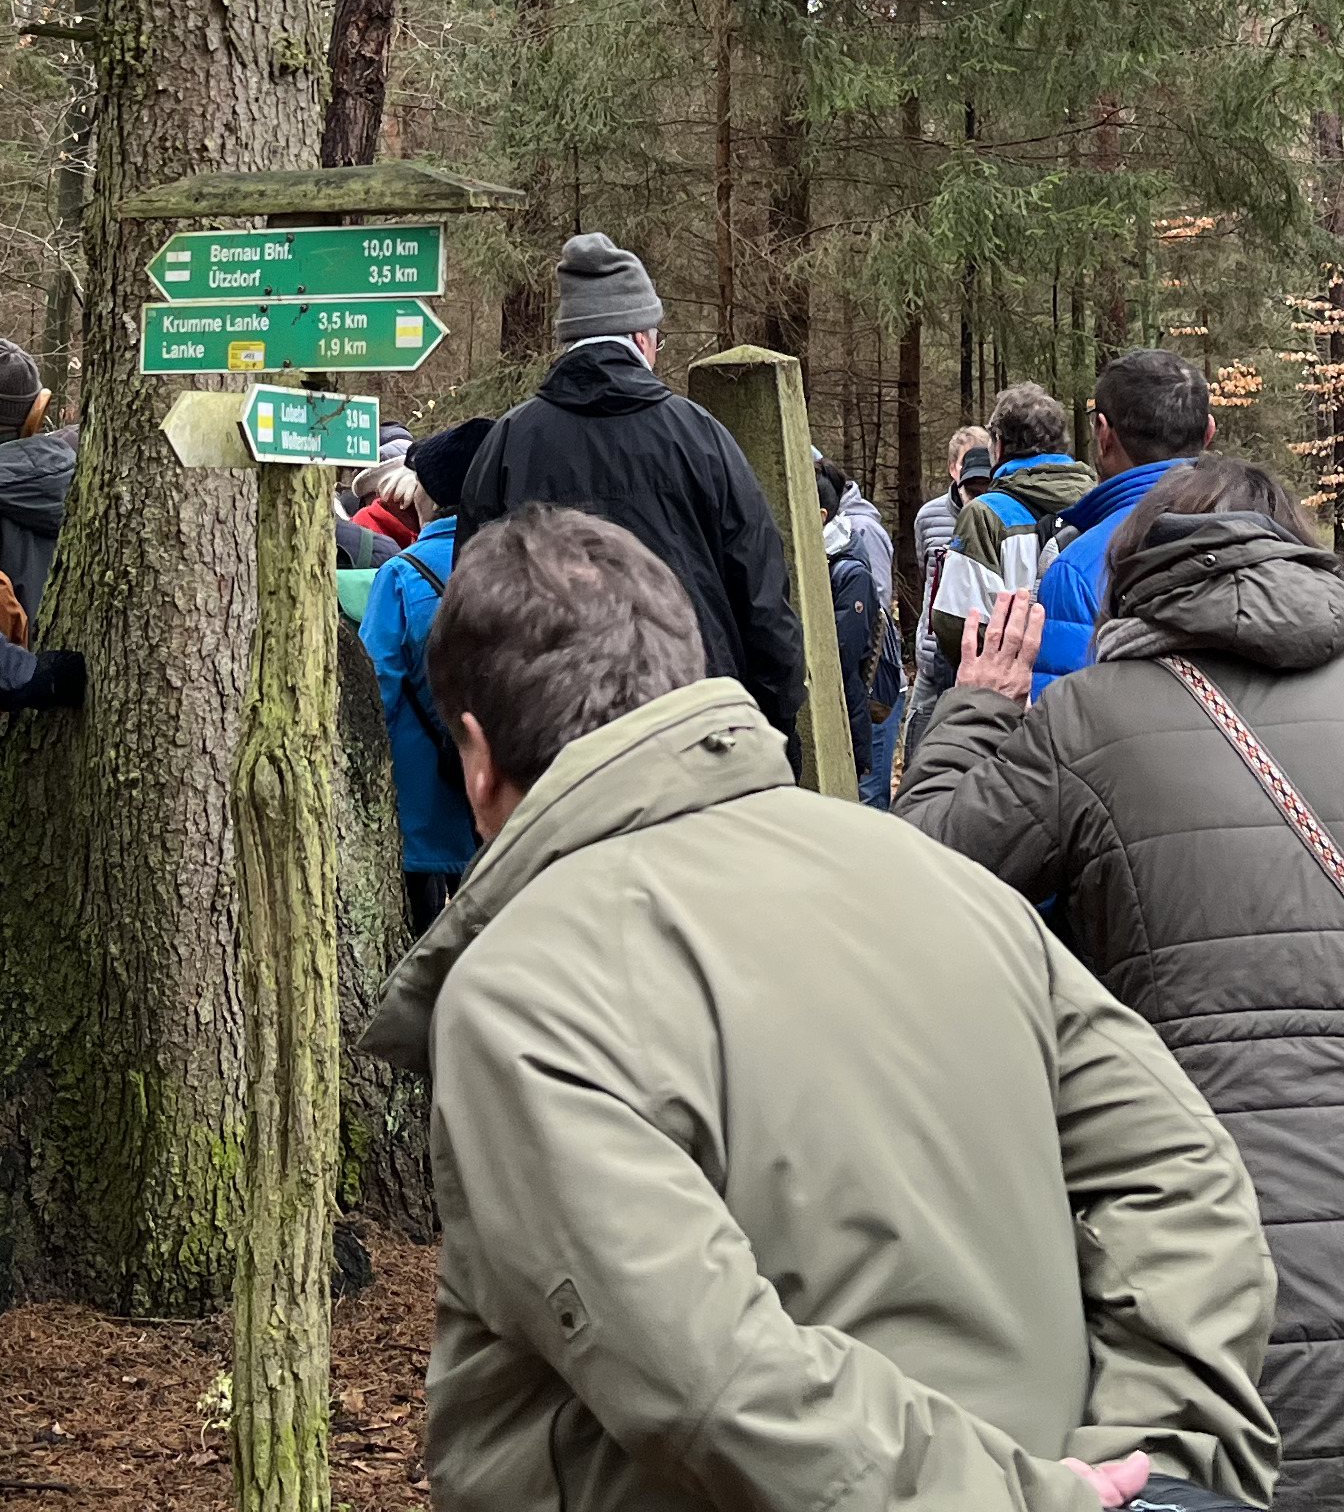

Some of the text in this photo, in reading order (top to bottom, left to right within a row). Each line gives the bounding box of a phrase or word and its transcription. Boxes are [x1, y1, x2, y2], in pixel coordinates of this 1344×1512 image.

[210, 238, 419, 262] Bernau Bhf. 10,0 km
[209, 264, 418, 288] Ützdorf 3,5 km
[163, 310, 368, 333] Krumme Lanke 3,5 km
[162, 337, 367, 359] Lanke 1,9 km
[359, 409, 370, 428] km
[359, 436, 370, 455] km
